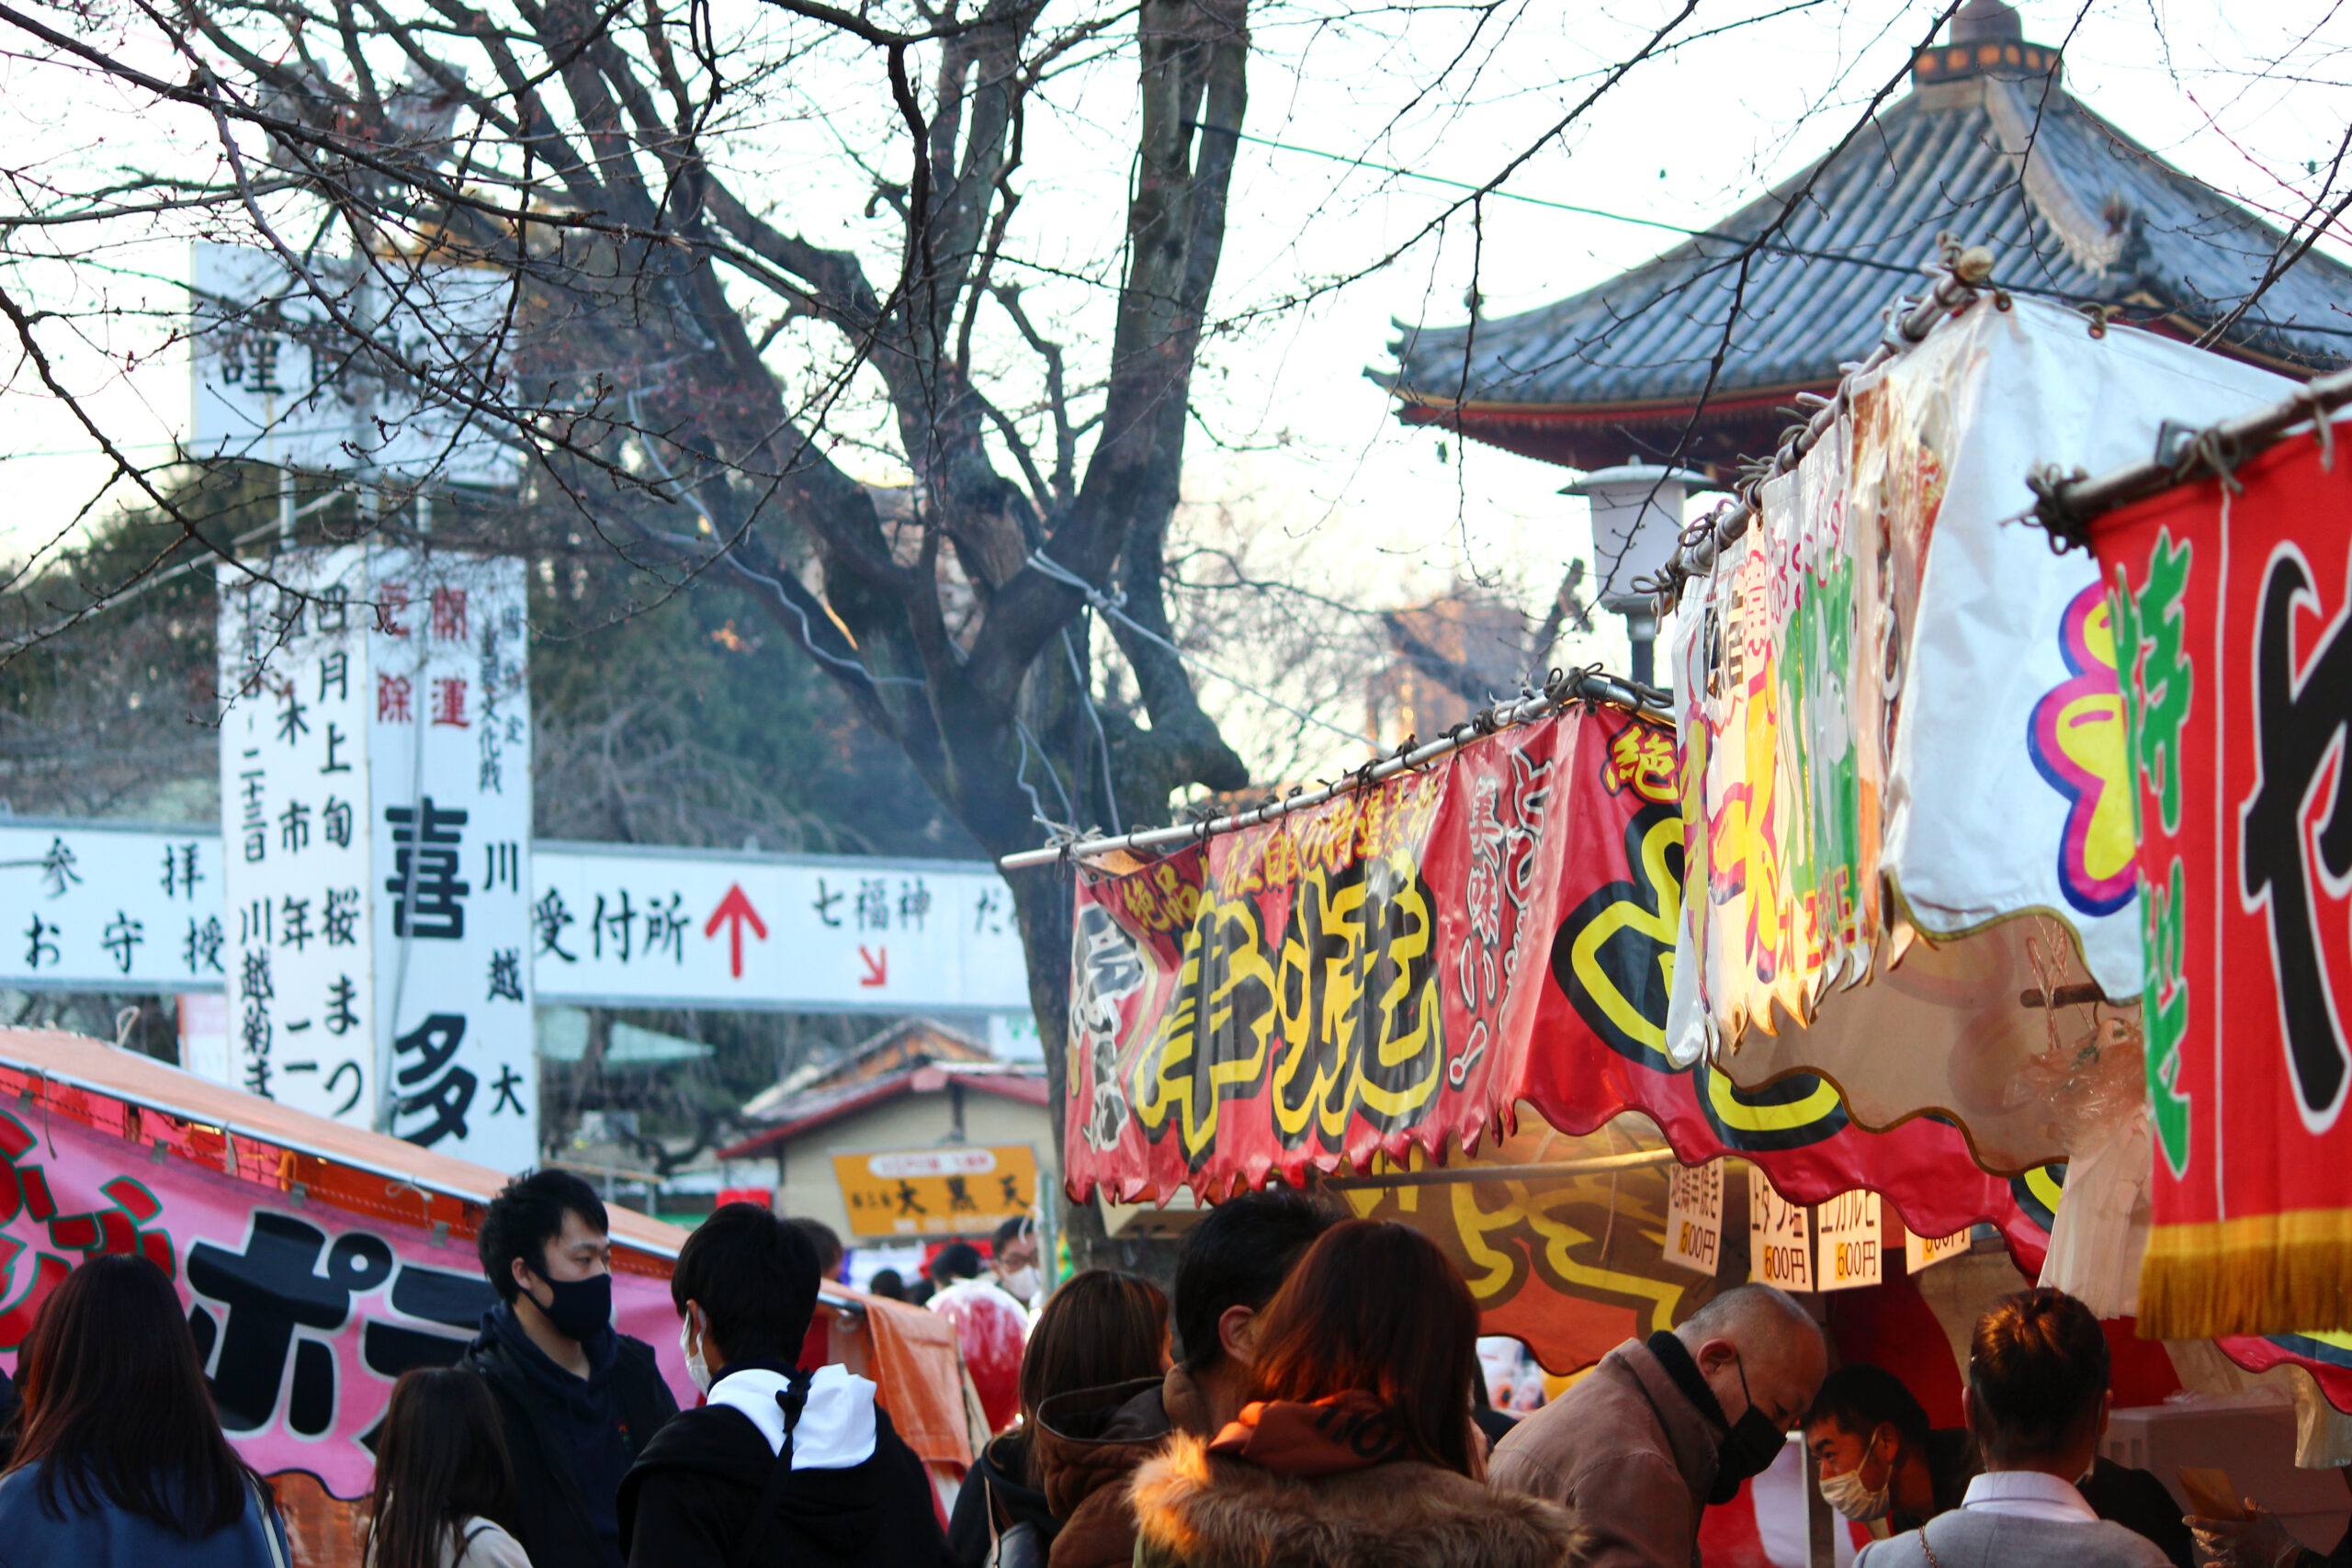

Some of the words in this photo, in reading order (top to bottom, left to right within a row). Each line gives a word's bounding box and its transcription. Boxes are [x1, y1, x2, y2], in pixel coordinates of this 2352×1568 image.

[531, 884, 692, 966] 受付所
[810, 876, 932, 932] 七福神
[385, 796, 478, 1148] 喜多
[484, 841, 526, 1117] 川越大
[1680, 1220, 1717, 1267] 600円
[1764, 1245, 1806, 1284] 600円
[1837, 1240, 1876, 1278] 600円
